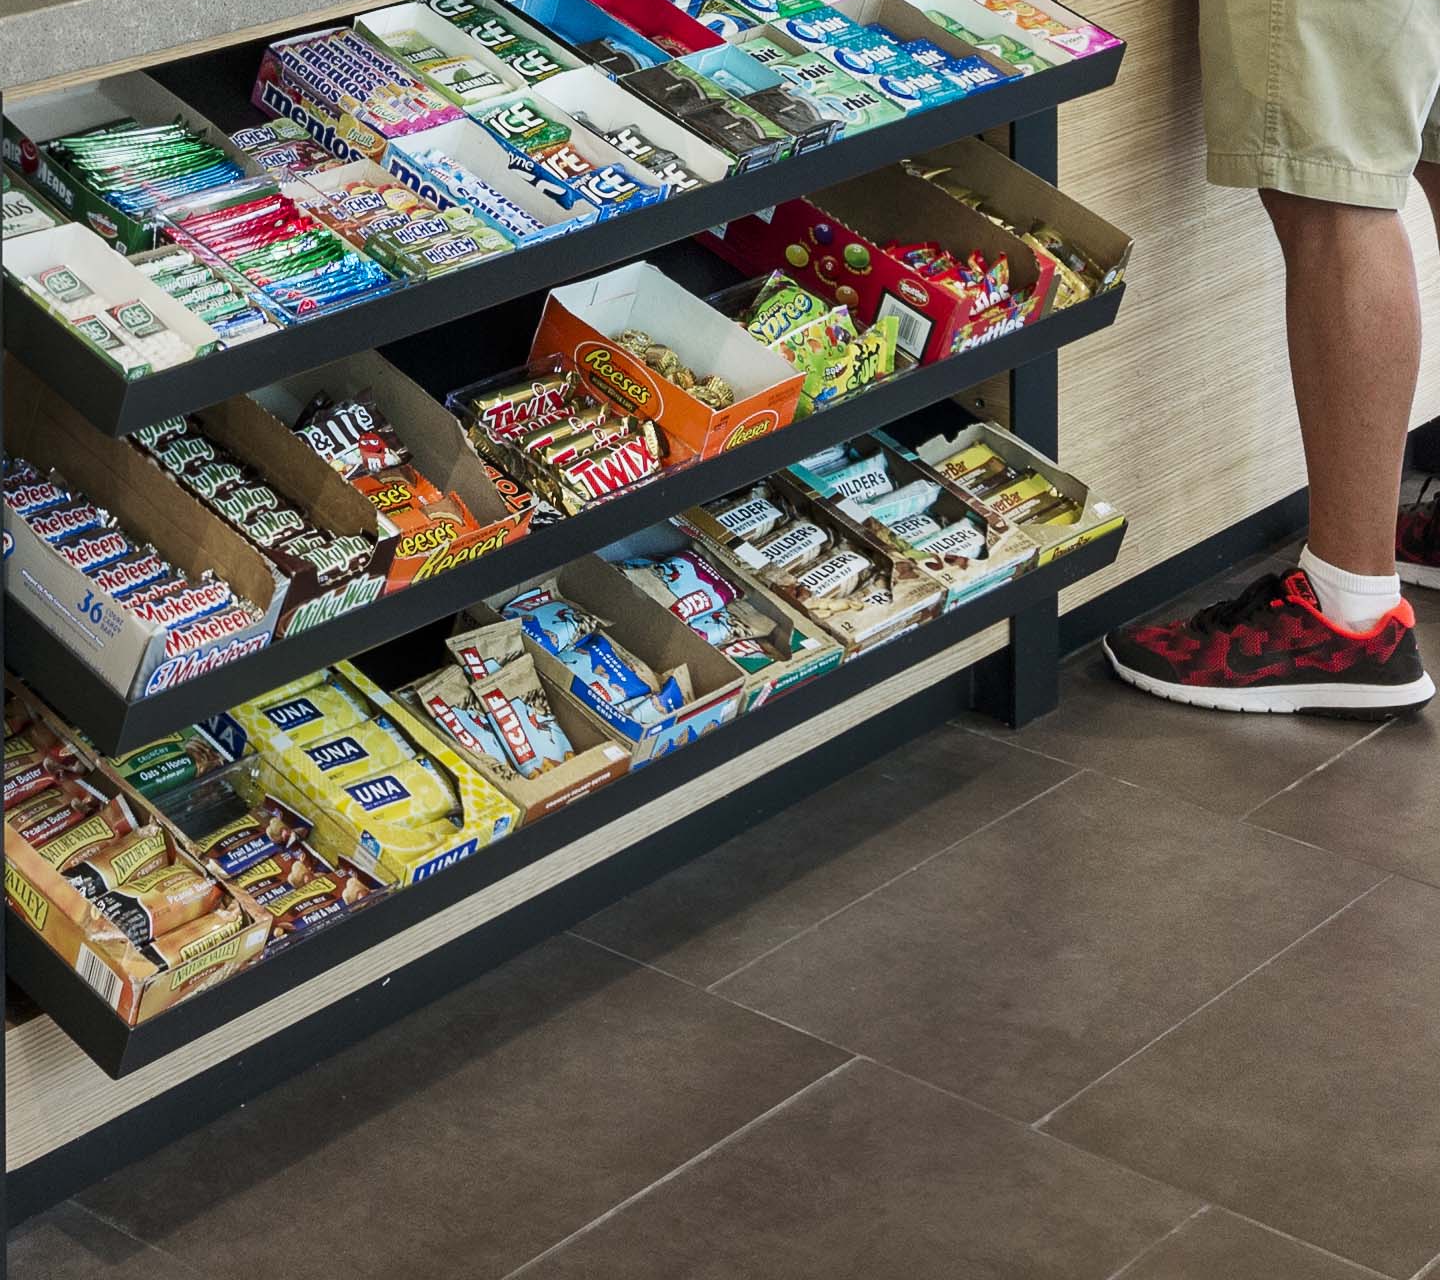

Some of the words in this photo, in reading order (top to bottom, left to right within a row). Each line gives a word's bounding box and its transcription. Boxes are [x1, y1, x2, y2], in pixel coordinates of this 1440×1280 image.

[799, 16, 851, 41] Orbit
[750, 47, 784, 64] bit
[848, 44, 898, 70] Orbit
[913, 48, 946, 66] bit
[282, 50, 342, 104] mentos
[895, 73, 943, 96] Orbit
[489, 101, 545, 138] ICE
[346, 129, 375, 146] fruit
[580, 167, 636, 205] ICE
[393, 218, 448, 244] HI-CHEW
[423, 237, 479, 265] HI-CHEW
[747, 292, 813, 345] Spree
[584, 347, 653, 407] Reese's
[724, 418, 771, 452] Reese's
[941, 460, 969, 482] erBar
[370, 482, 414, 510] ese's
[733, 517, 757, 535] PROTEIN
[757, 514, 770, 525] BAR
[895, 516, 932, 537] DER's
[64, 532, 124, 567] keteers
[780, 545, 801, 563] PROTEIN
[941, 572, 955, 585] 12
[76, 588, 104, 625] 36
[840, 620, 854, 633] 12
[271, 702, 315, 725] UNA
[588, 689, 627, 724] CHOCOLATE
[595, 704, 613, 721] CHIP
[489, 696, 529, 747] CLIF
[138, 745, 170, 764] CRUNCHY
[139, 765, 159, 781] Oats
[168, 755, 192, 772] Honey
[227, 845, 245, 861] Fruit
[252, 837, 266, 850] Nut
[303, 912, 321, 926] Fruit
[327, 903, 341, 916] Nut
